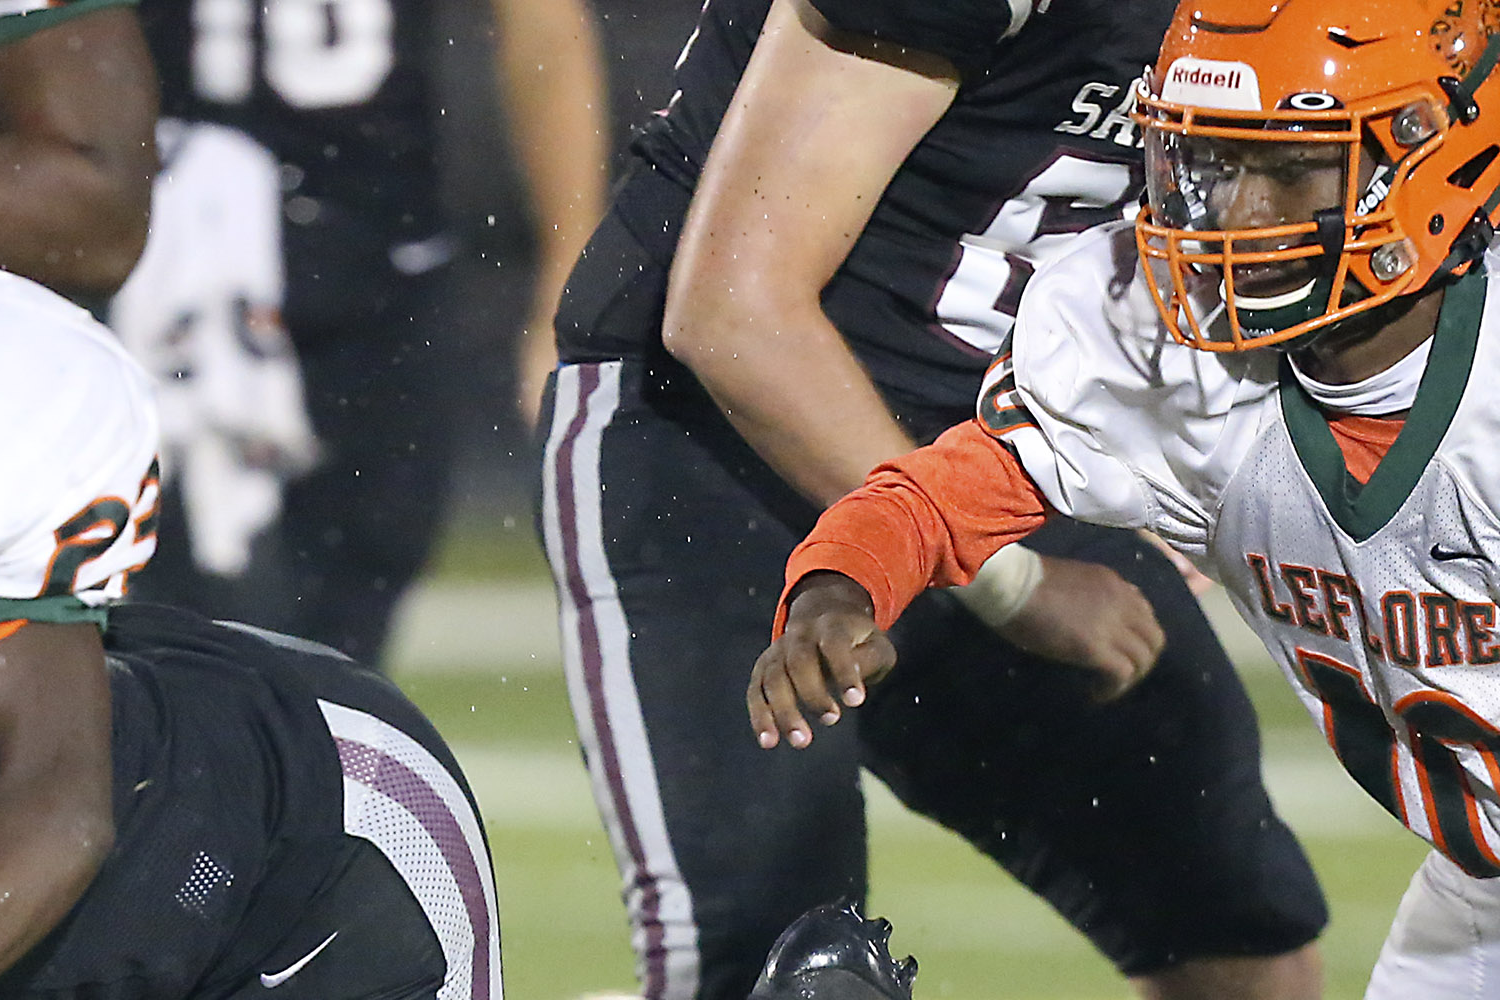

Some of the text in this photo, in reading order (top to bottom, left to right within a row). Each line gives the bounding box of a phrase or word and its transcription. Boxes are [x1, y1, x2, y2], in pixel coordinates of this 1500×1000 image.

[1172, 66, 1242, 90] Riddell
[1054, 80, 1145, 148] SA
[1247, 552, 1500, 669] LEFLORE
